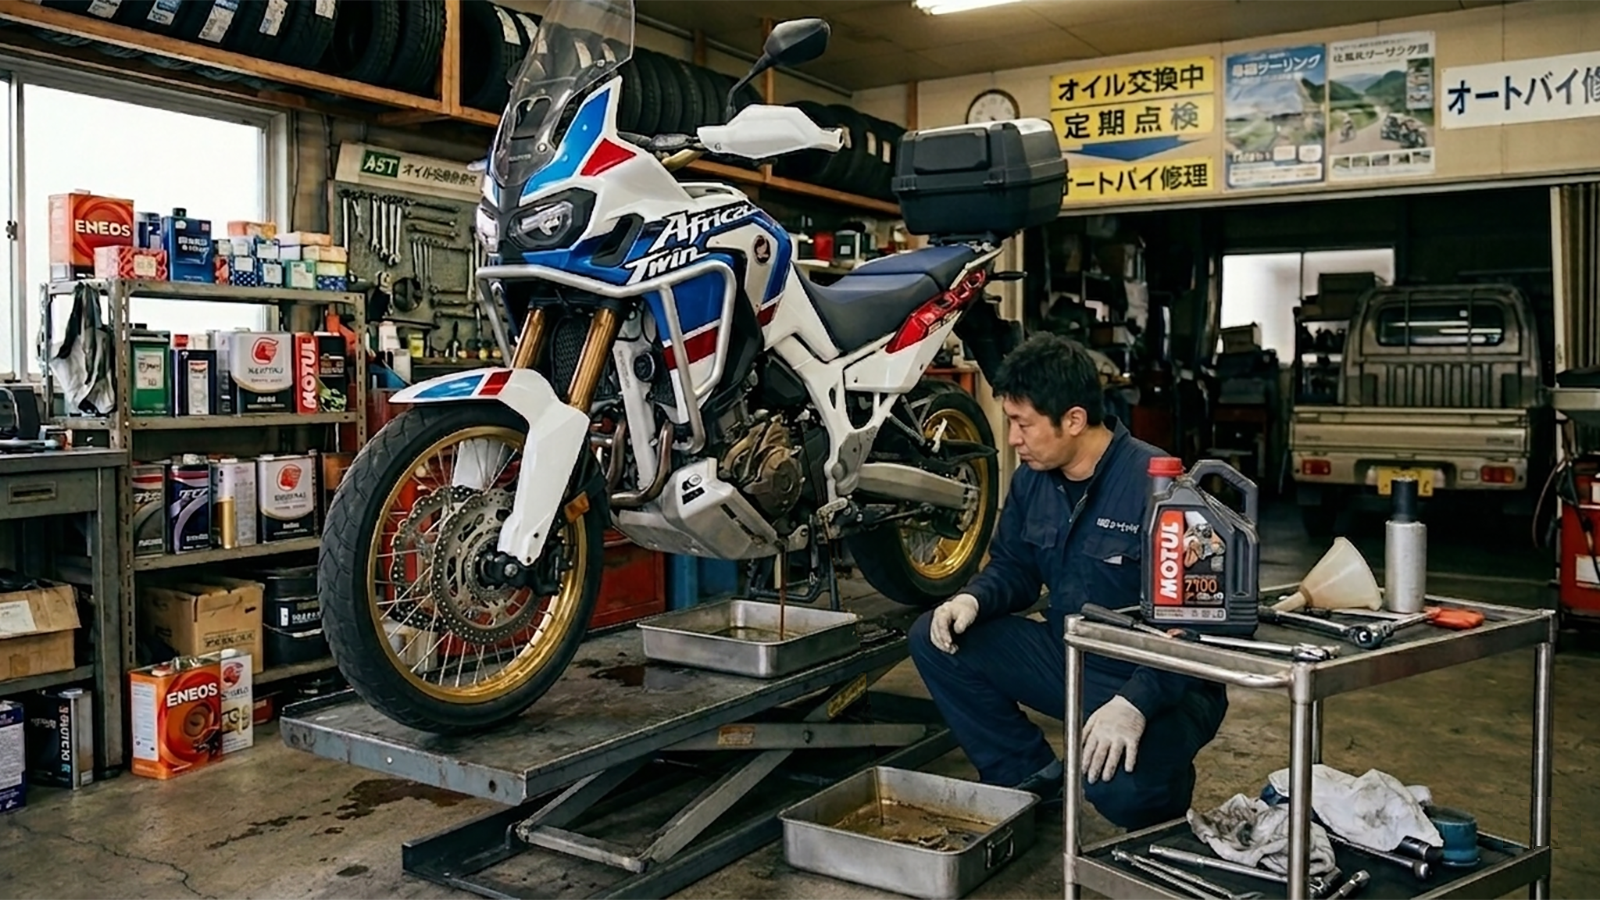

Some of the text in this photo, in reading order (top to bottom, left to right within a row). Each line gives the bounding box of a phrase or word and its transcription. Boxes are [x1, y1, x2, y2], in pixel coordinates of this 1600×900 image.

[1058, 64, 1204, 101] オイル交換中
[1064, 101, 1199, 139] 定期点検
[364, 155, 398, 175] AST
[75, 219, 131, 237] ENEOS
[648, 203, 760, 253] Africa
[624, 245, 710, 286] Twin
[1160, 521, 1179, 599] MOTUL
[166, 682, 218, 708] ENEOS
